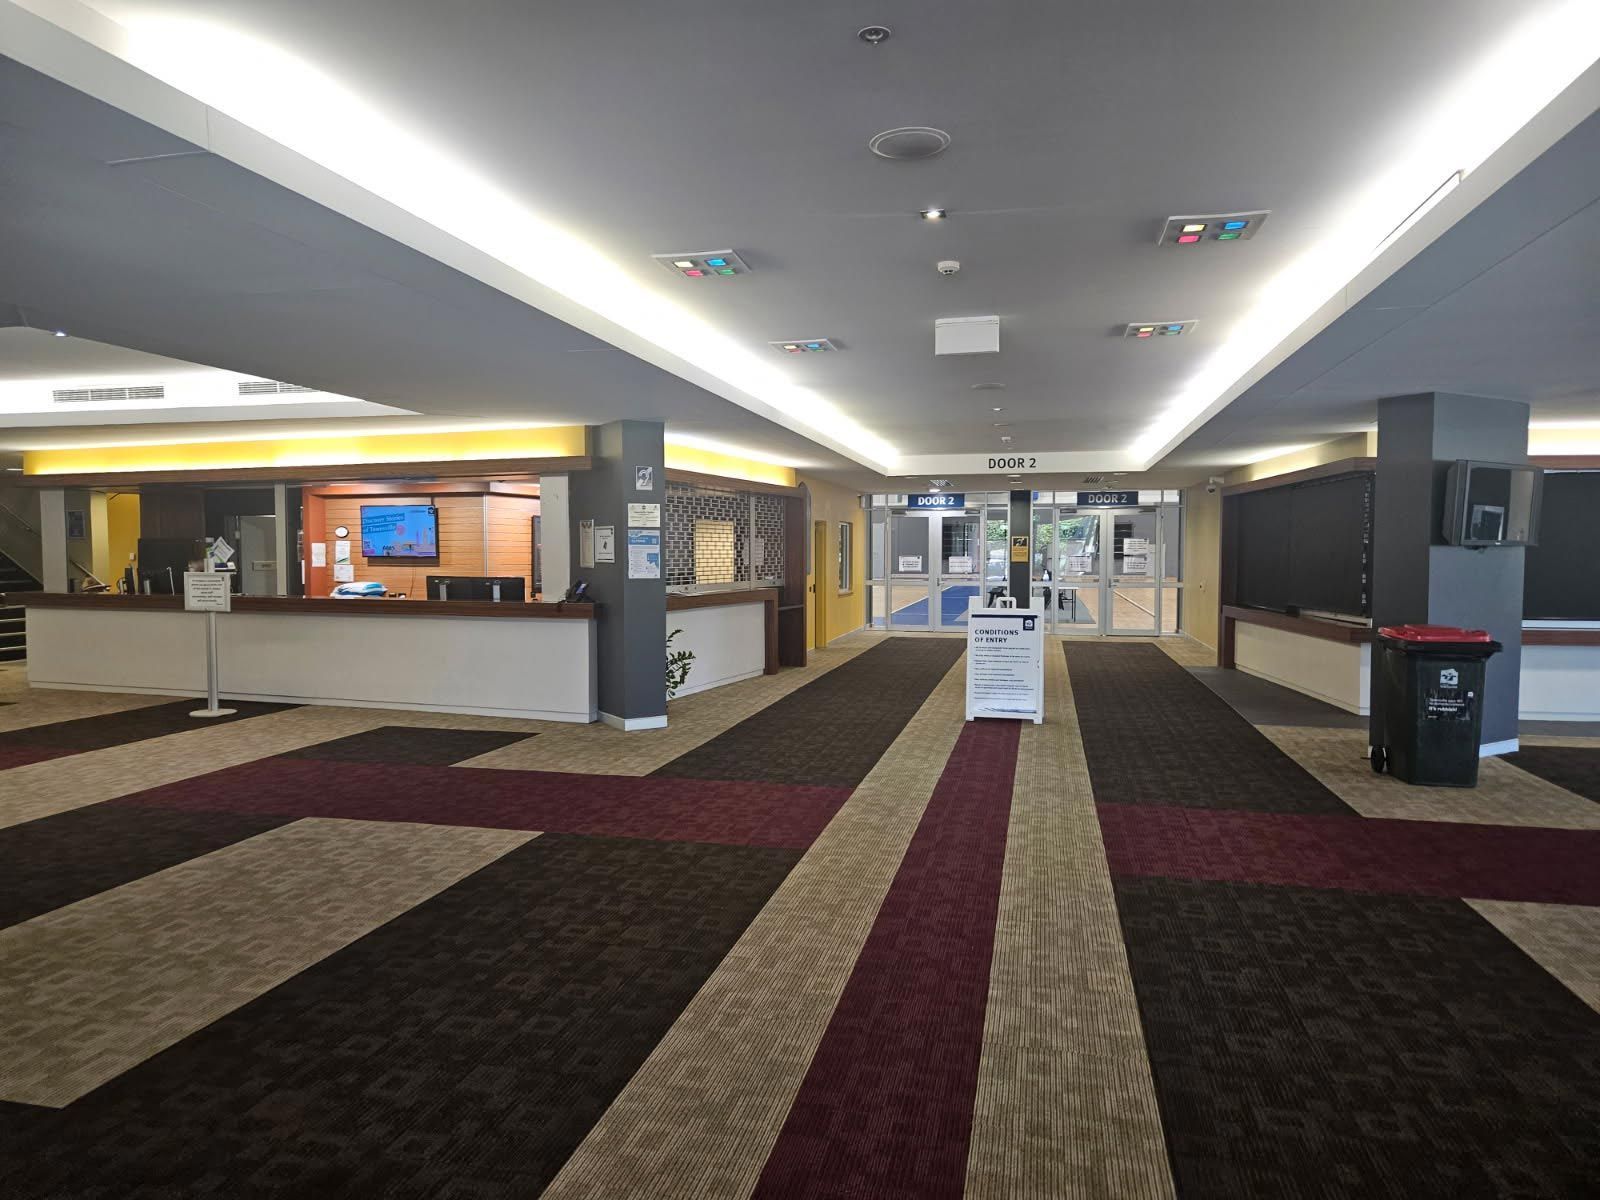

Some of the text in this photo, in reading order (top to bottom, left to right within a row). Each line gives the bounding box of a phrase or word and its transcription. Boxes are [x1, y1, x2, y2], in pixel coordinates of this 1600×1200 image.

[988, 457, 1037, 469] DOOR 2
[917, 496, 955, 506] DOOR 2
[1088, 494, 1128, 503] DOOR 2
